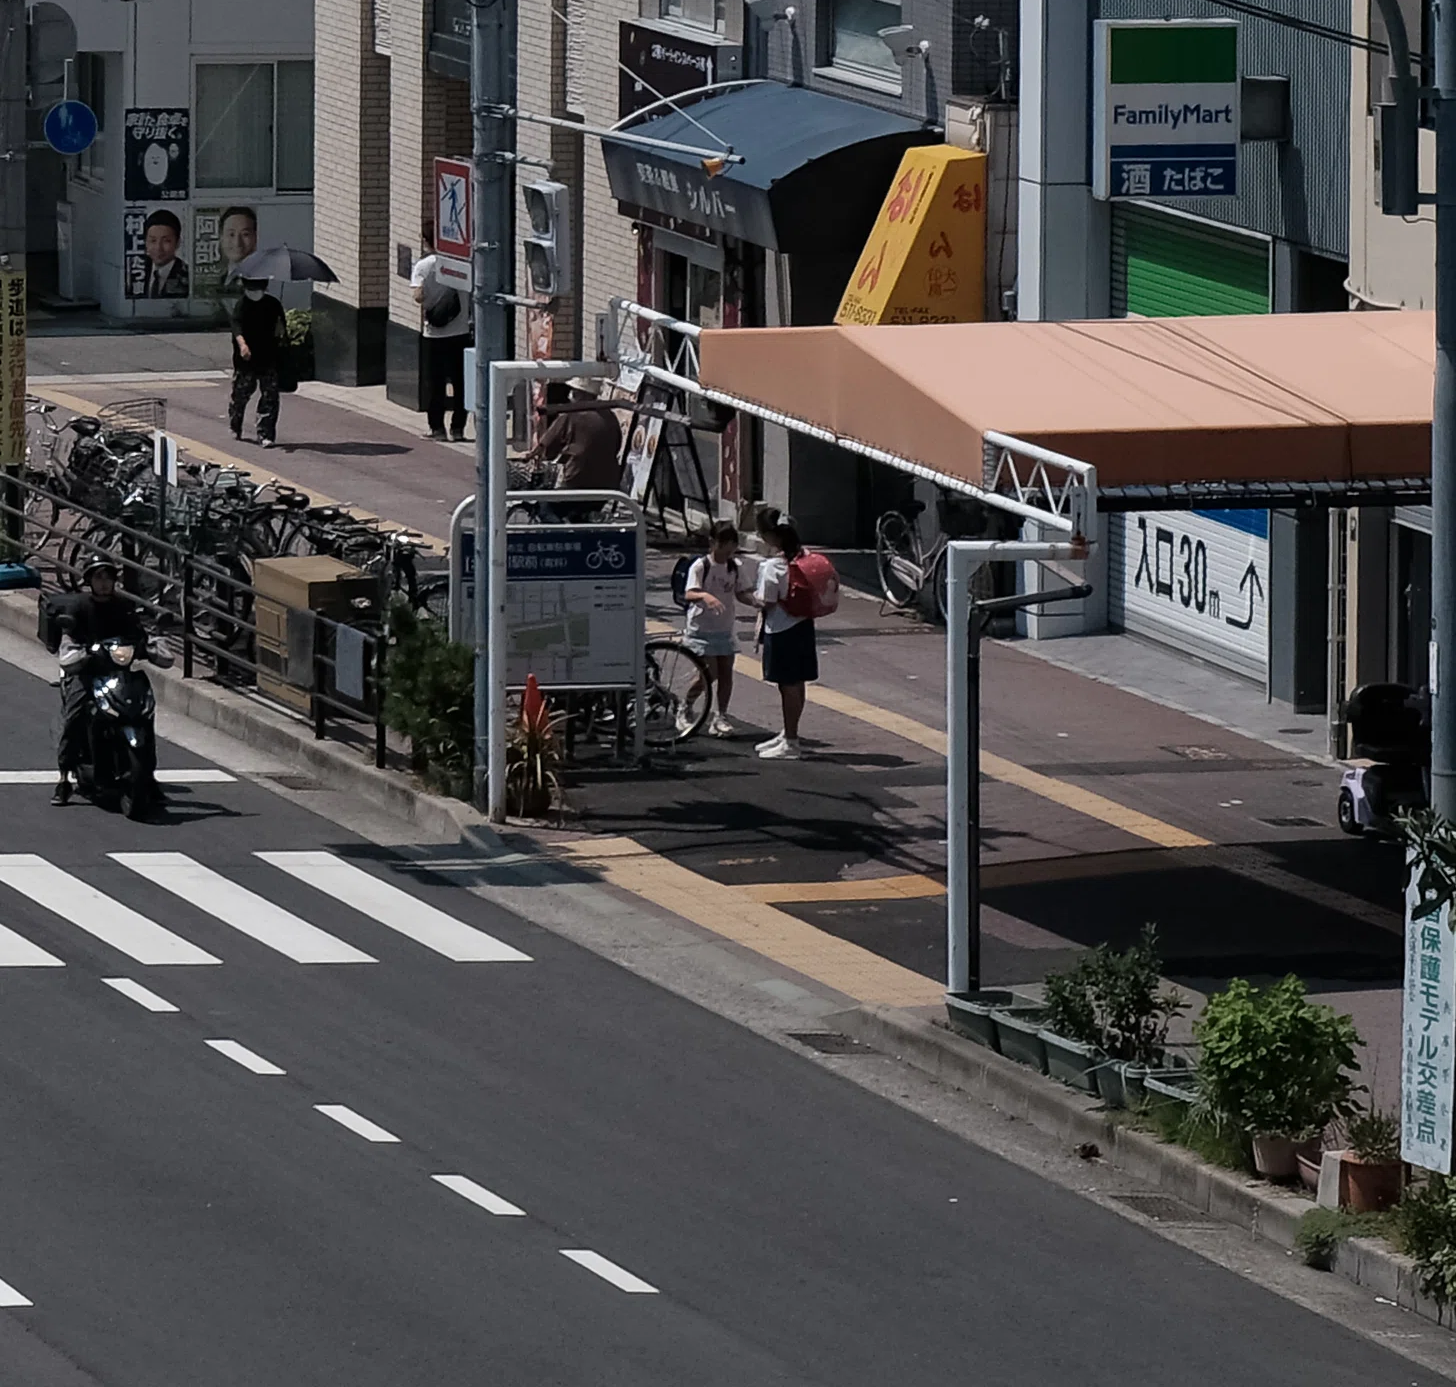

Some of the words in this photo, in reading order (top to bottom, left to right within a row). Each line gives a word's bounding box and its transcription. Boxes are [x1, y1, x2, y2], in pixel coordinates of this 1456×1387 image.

[1113, 106, 1233, 130] FamilyMart
[1122, 163, 1153, 195] 酒
[1163, 167, 1226, 192] たばこ
